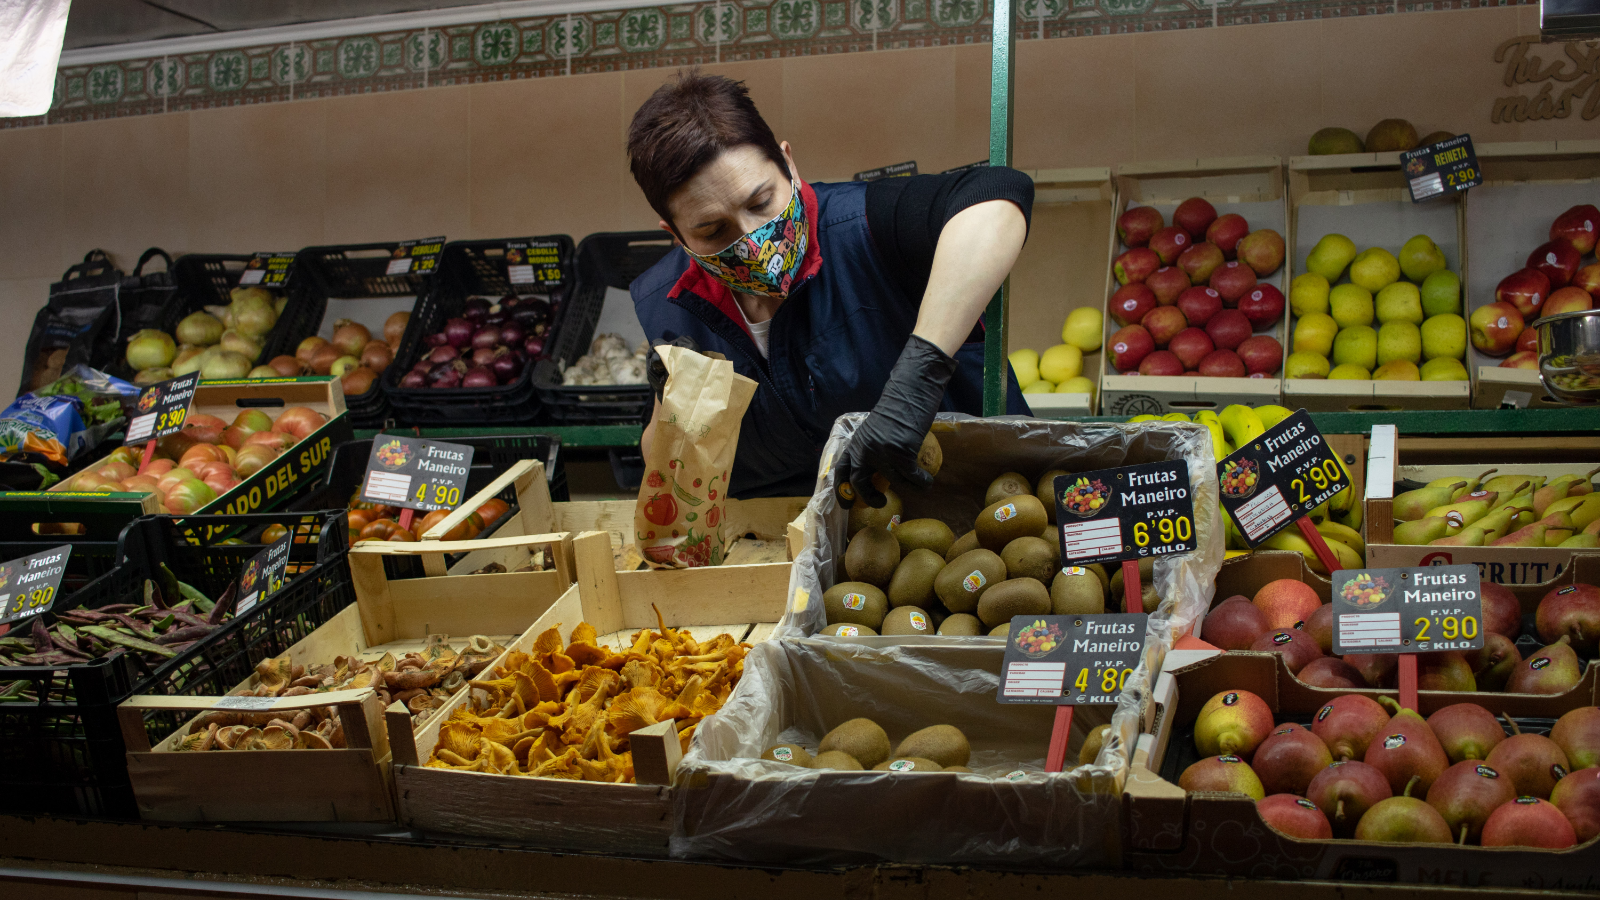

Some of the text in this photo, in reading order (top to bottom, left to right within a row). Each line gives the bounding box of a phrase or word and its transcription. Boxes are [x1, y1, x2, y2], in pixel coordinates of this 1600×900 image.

[1491, 82, 1571, 123] más
[1405, 136, 1468, 159] Frutas Maneiro
[1434, 146, 1468, 167] REINETA
[1446, 167, 1475, 186] 2'90
[411, 243, 442, 256] CEBOLLAS
[526, 247, 559, 256] CEBOLLA
[170, 378, 193, 392] Frutas
[162, 389, 193, 405] Maneiro
[157, 408, 185, 431] 3'90
[162, 426, 179, 436] KILO.
[1263, 421, 1306, 453] Frutas
[428, 446, 464, 461] Frutas
[1266, 434, 1321, 474] Maneiro
[265, 462, 298, 499] DEL
[299, 436, 331, 474] SUR
[417, 459, 466, 475] Maneiro
[1295, 456, 1322, 475] P.V.P.
[431, 477, 455, 486] P.V.P.
[1128, 470, 1177, 487] Frutas
[1290, 458, 1341, 504] 2'90
[416, 483, 460, 506] 4'90
[1120, 486, 1187, 507] Maneiro
[1314, 483, 1346, 504] KILO.
[1146, 508, 1178, 519] P.V.P.
[1133, 515, 1192, 547] 6'90
[267, 541, 287, 562] Frutas
[1152, 543, 1190, 555] KILO.
[28, 553, 62, 570] Frutas
[261, 555, 287, 580] Maneiro
[17, 566, 62, 586] Maneiro
[1413, 572, 1467, 586] Frutas
[29, 582, 49, 591] P.V.P.
[1404, 588, 1476, 603] Maneiro
[12, 586, 54, 613] 3'90
[20, 606, 45, 618] KILO.
[1430, 608, 1465, 616] P.V.P.
[1085, 620, 1135, 635] Frutas
[1414, 615, 1477, 642] 2'90
[1072, 638, 1140, 653] Maneiro
[1433, 641, 1476, 650] KILO.
[1074, 667, 1134, 693] 4'80
